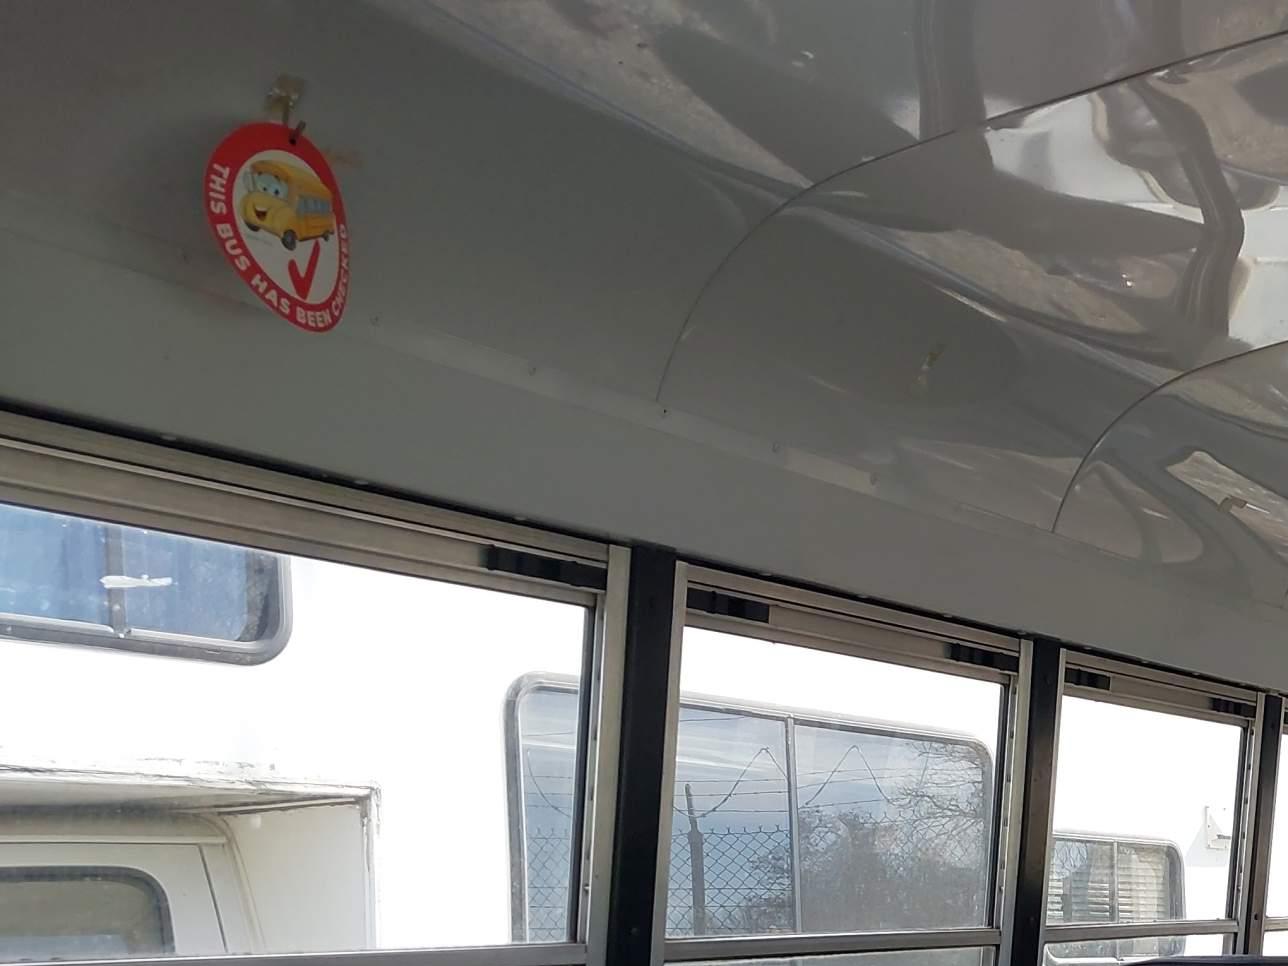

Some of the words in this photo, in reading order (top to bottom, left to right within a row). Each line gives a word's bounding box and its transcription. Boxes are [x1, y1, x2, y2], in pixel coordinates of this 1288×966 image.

[210, 163, 231, 215] THIS
[216, 223, 251, 271] BUS
[250, 273, 291, 314] HAS
[295, 306, 332, 328] BEEN
